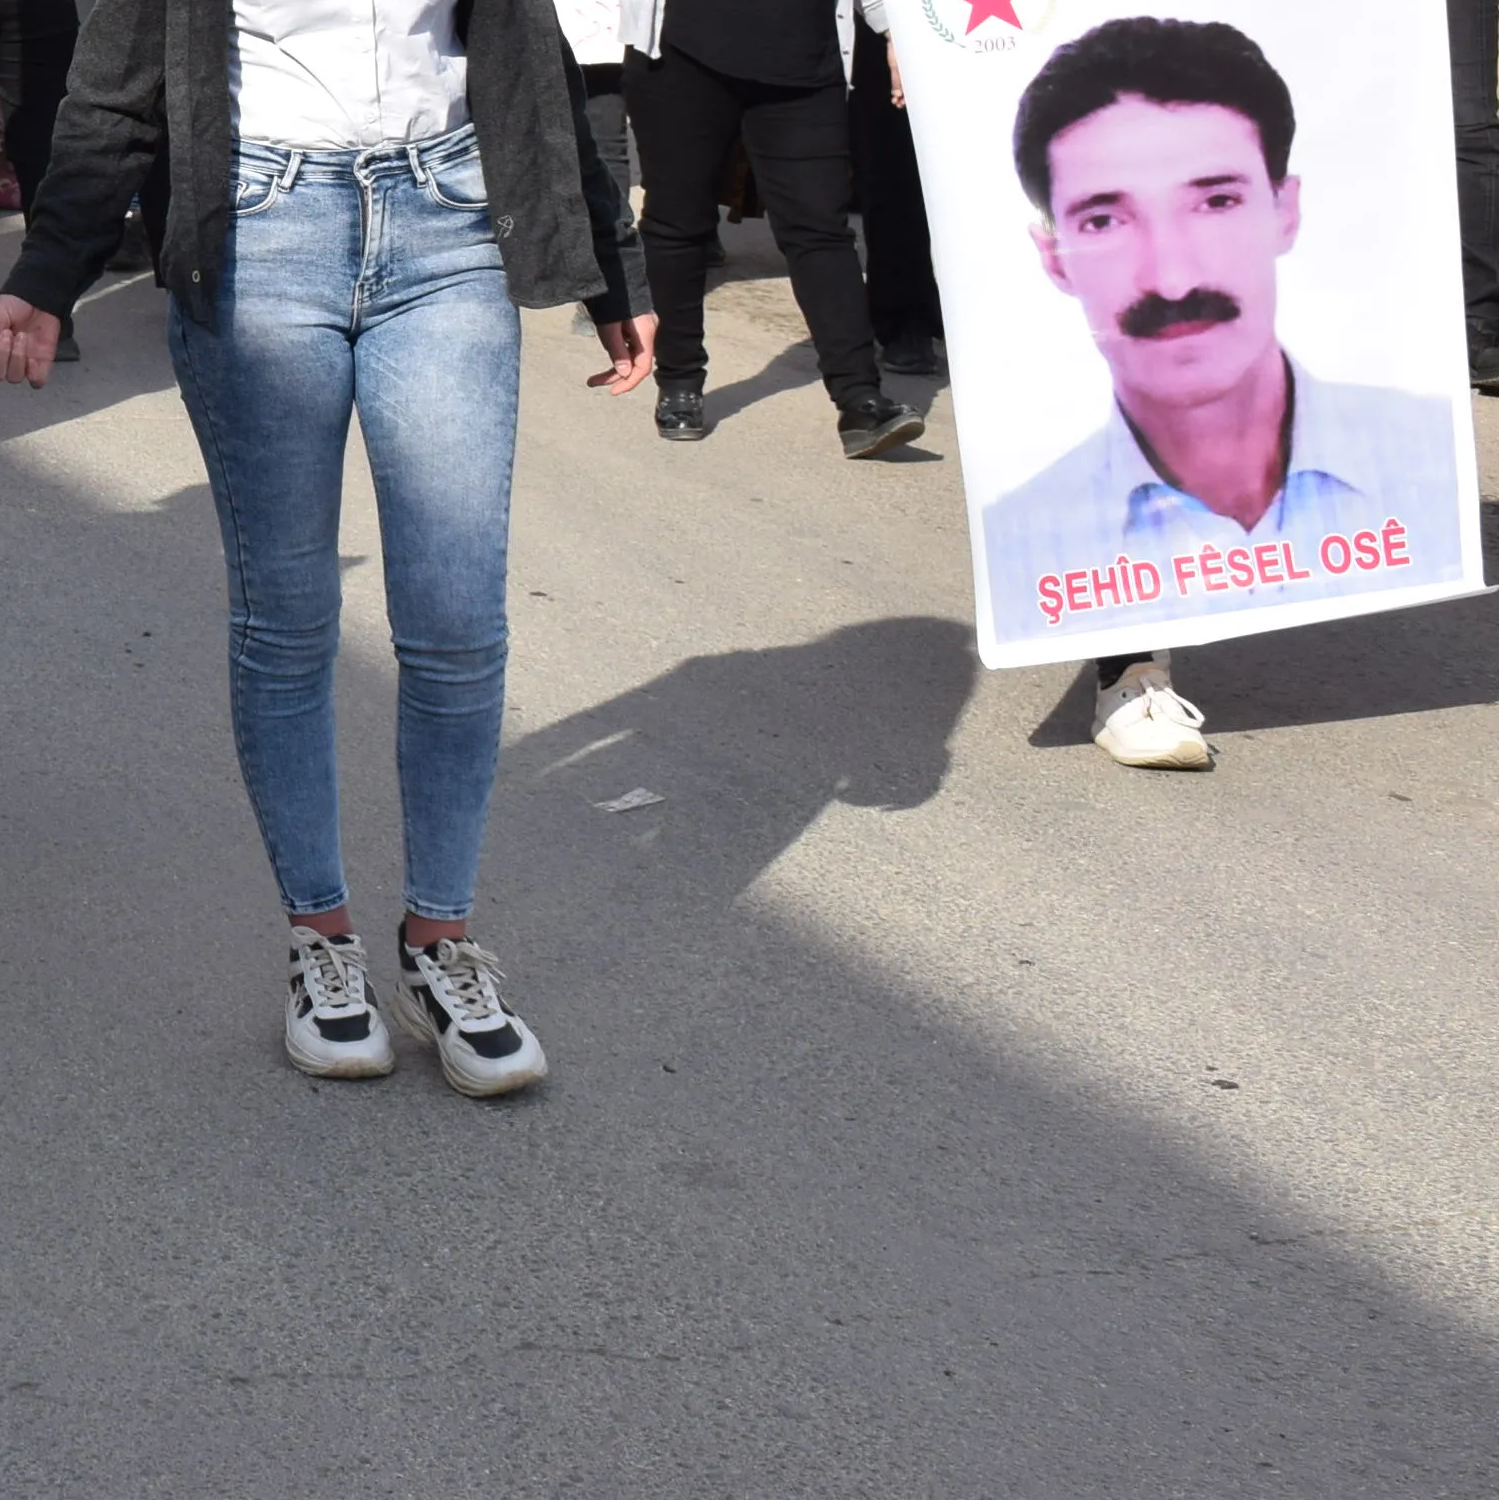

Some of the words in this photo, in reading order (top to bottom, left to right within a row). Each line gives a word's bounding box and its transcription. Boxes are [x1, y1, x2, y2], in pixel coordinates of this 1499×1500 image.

[974, 36, 1017, 54] 2003
[1038, 555, 1162, 624] ŞEHÎD
[1173, 544, 1310, 596] FÊSEL
[1321, 517, 1411, 574] OSÊ
